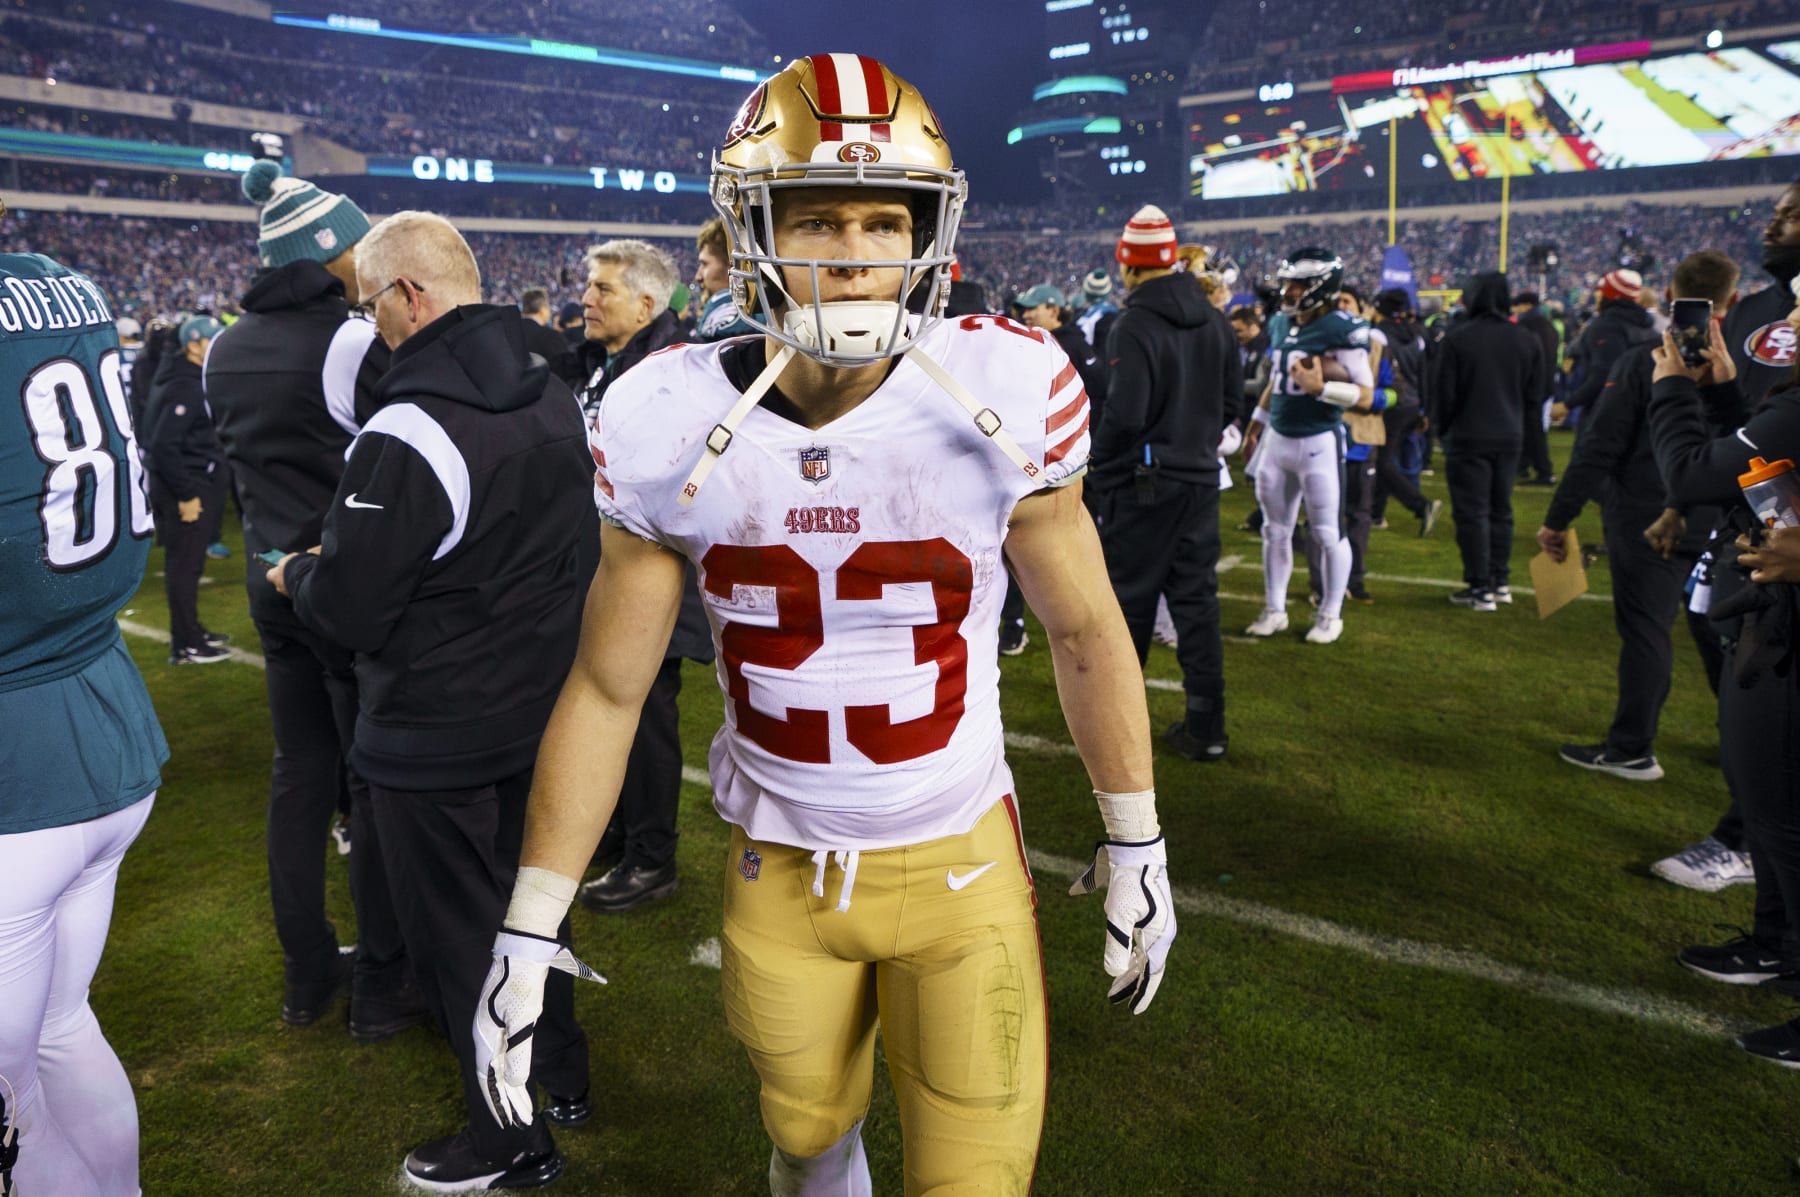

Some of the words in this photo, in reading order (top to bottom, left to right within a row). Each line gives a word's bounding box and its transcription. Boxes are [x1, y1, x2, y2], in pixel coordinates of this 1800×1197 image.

[1110, 27, 1149, 45] TWO
[412, 156, 494, 183] ONE
[589, 166, 677, 193] TWO
[1109, 160, 1146, 175] TWO
[804, 461, 826, 478] NFL
[1023, 461, 1039, 478] 23
[683, 482, 698, 498] 23
[784, 506, 861, 534] 49ERS
[701, 537, 974, 765] 23
